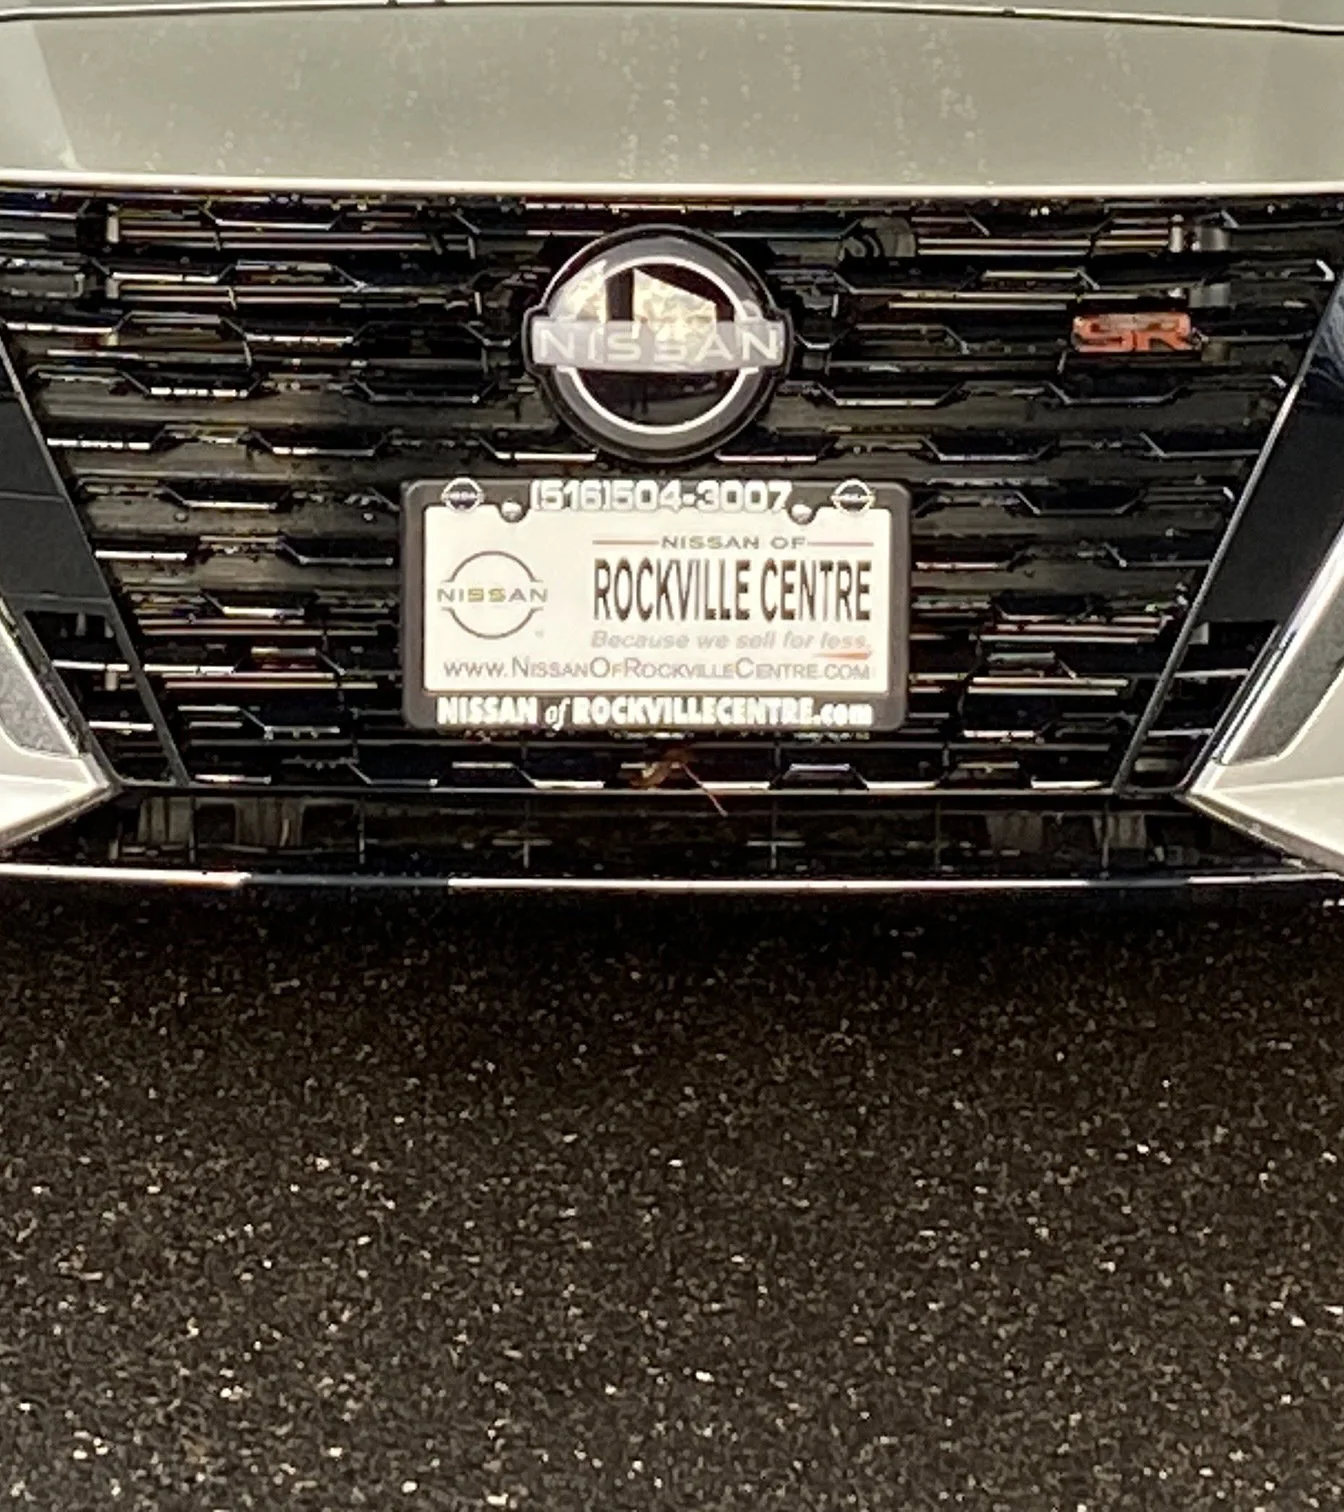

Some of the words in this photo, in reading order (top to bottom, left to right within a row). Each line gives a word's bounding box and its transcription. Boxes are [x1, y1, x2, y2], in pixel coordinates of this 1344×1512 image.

[540, 326, 778, 362] NISSAN
[1071, 312, 1201, 353] SR
[662, 536, 759, 550] NISSAN
[771, 536, 805, 550] OF
[437, 588, 548, 603] NISSAN
[594, 557, 751, 621] ROCKVILLE
[760, 558, 872, 621] CENTRE
[591, 630, 690, 649] Because
[697, 634, 728, 649] we
[735, 631, 776, 649] sell
[783, 631, 815, 649] for
[437, 696, 538, 724] NISSAN
[545, 697, 571, 731] of
